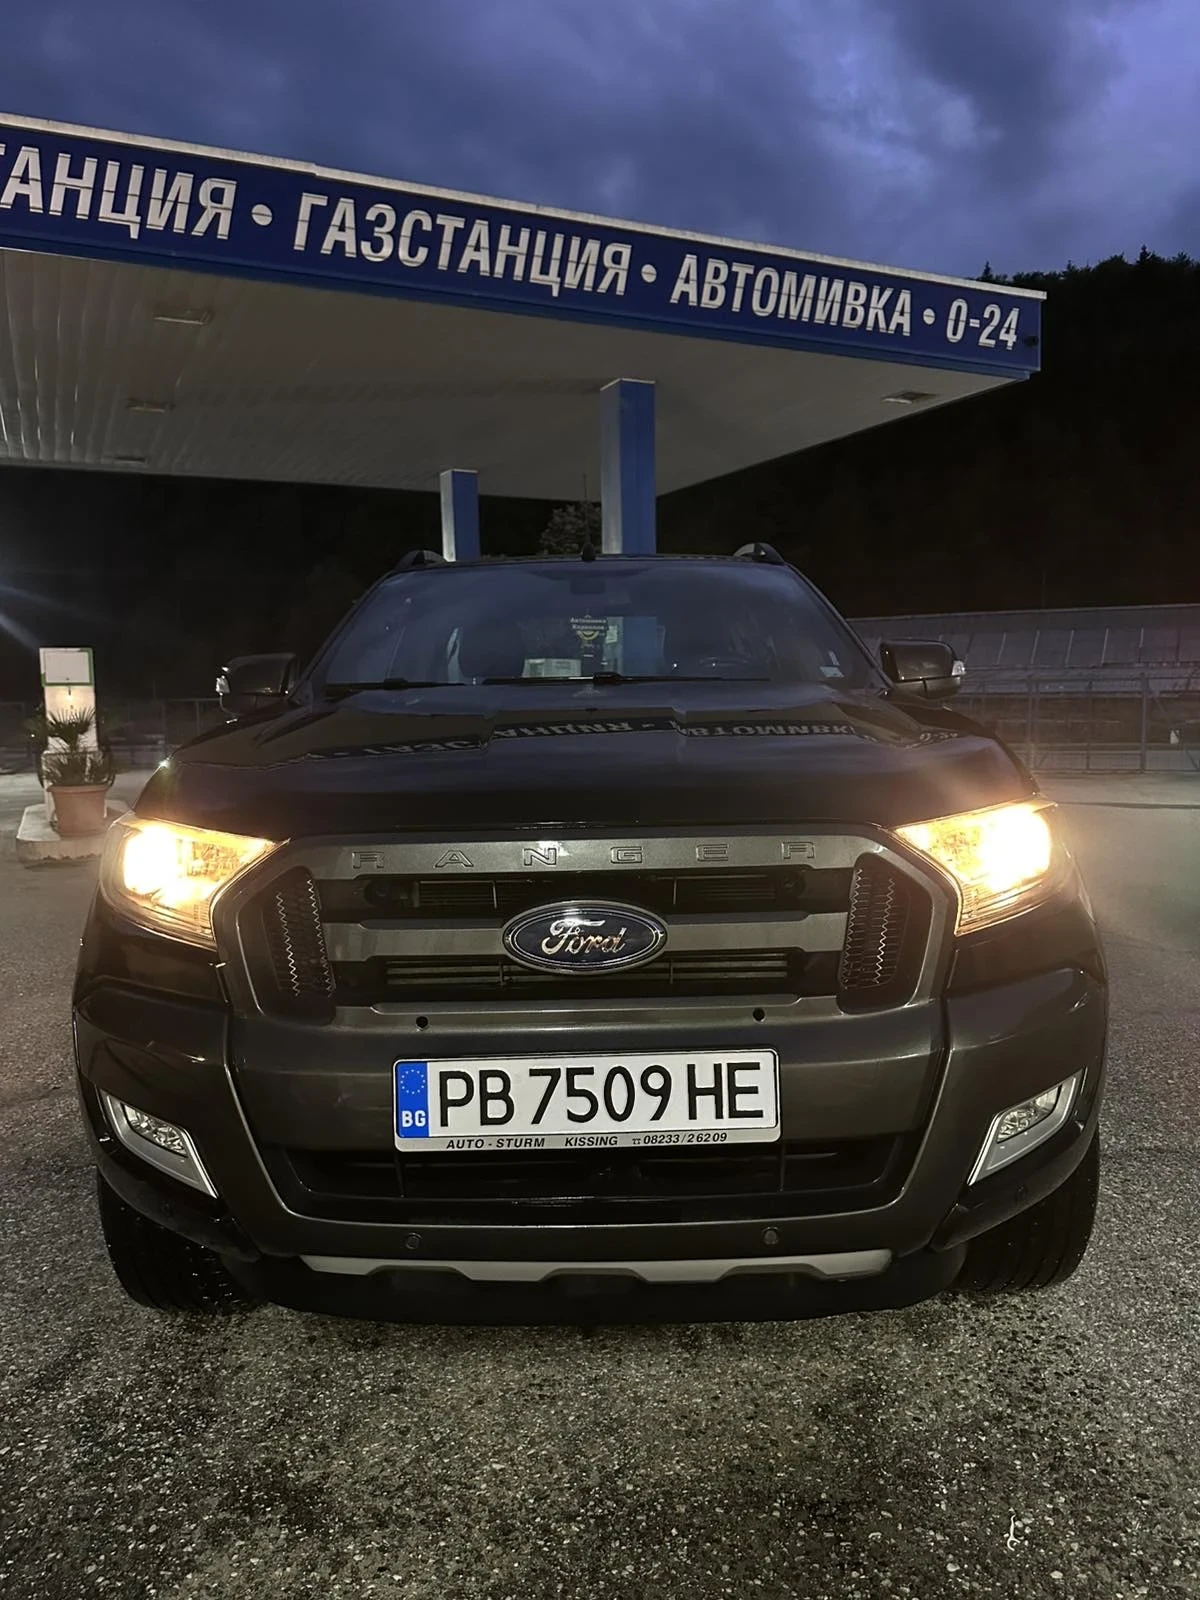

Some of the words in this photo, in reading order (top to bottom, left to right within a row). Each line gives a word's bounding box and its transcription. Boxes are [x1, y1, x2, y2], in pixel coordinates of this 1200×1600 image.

[0, 142, 237, 240] АНЦИЯ
[294, 192, 632, 297] ГАЗСТАНЦИЯ
[670, 253, 912, 337] АВТОМИВКА
[946, 298, 1020, 351] 0-24
[352, 840, 815, 870] RANGER
[540, 918, 627, 954] Ford
[439, 1068, 515, 1128] PB
[528, 1064, 672, 1125] 7509
[687, 1061, 764, 1121] HE
[402, 1110, 426, 1128] BG
[446, 1138, 485, 1150] AUTO
[496, 1137, 545, 1149] STURM
[564, 1136, 618, 1147] KISSING
